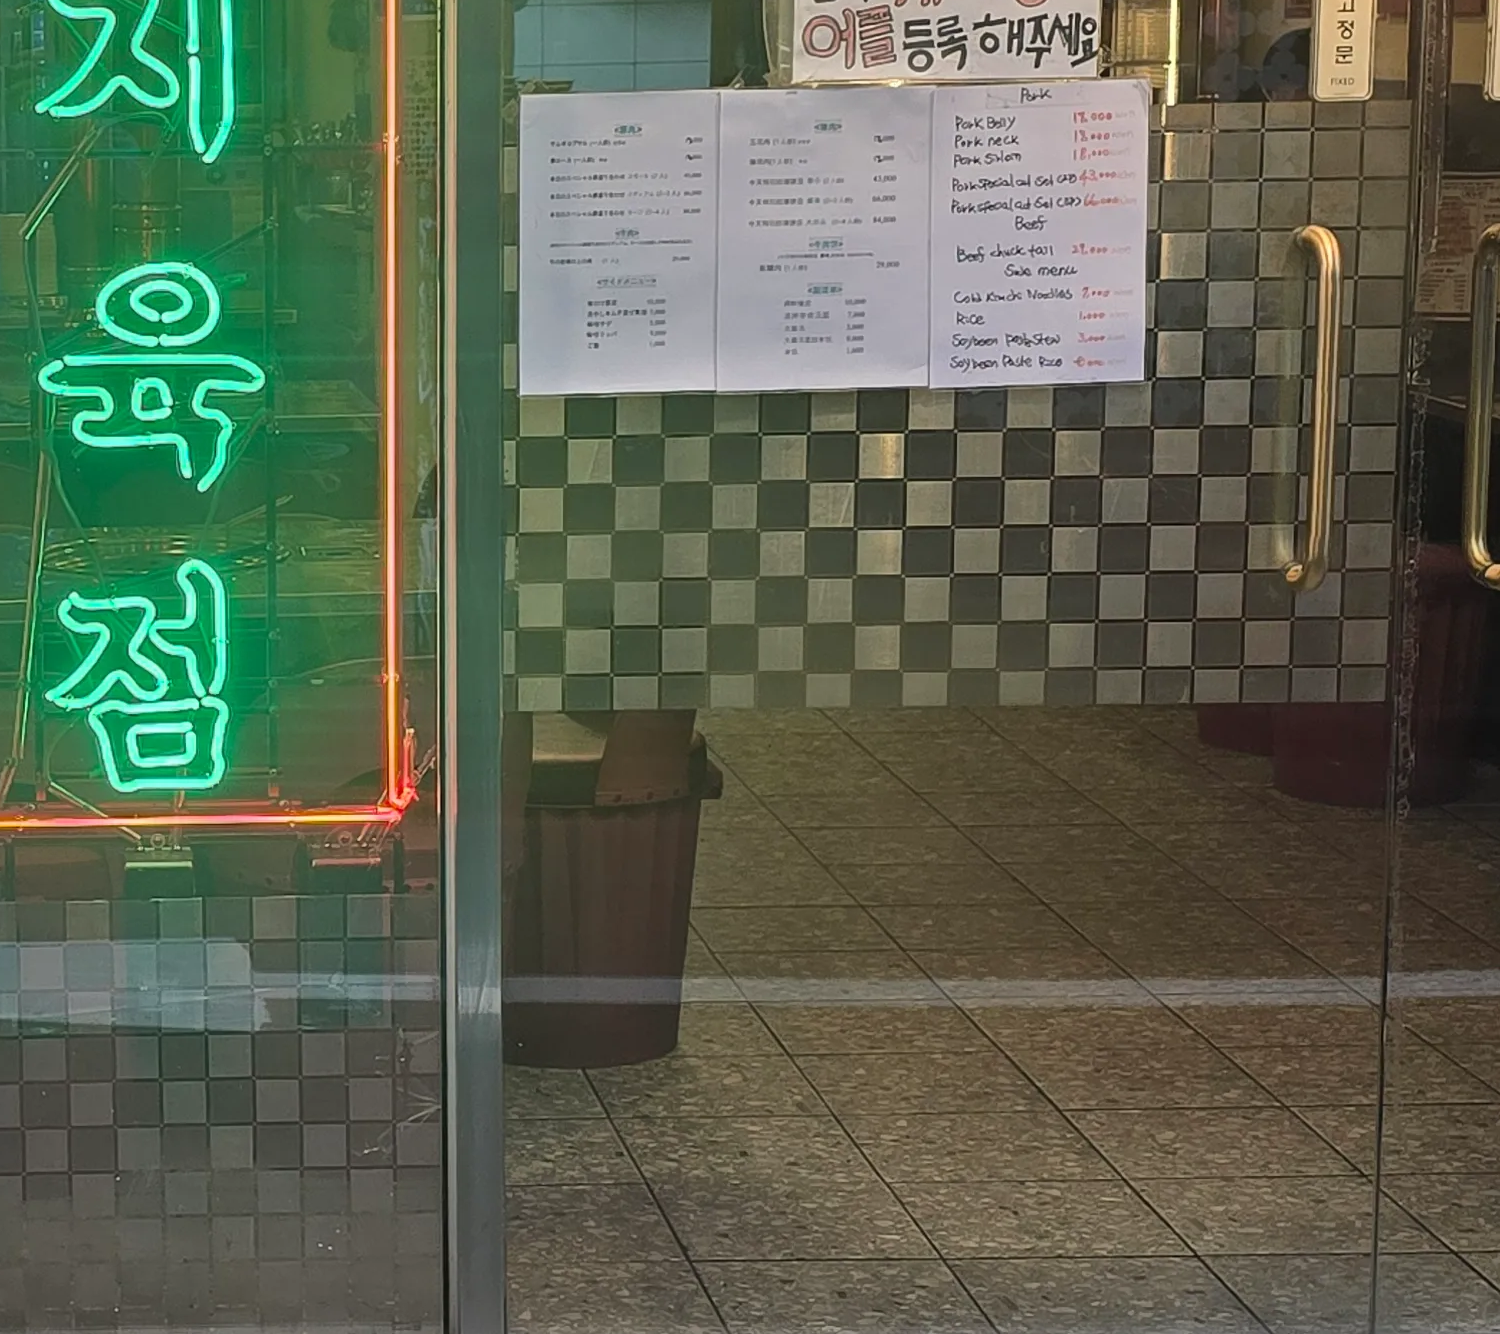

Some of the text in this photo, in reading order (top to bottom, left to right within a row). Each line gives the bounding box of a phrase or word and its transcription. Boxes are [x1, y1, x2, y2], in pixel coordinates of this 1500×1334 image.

[902, 14, 968, 73] 등록
[973, 12, 1100, 69] 해주세요
[1330, 76, 1355, 87] FIXED
[1020, 87, 1052, 104] Pork
[954, 135, 983, 149] Pork
[1015, 216, 1047, 231] Beef
